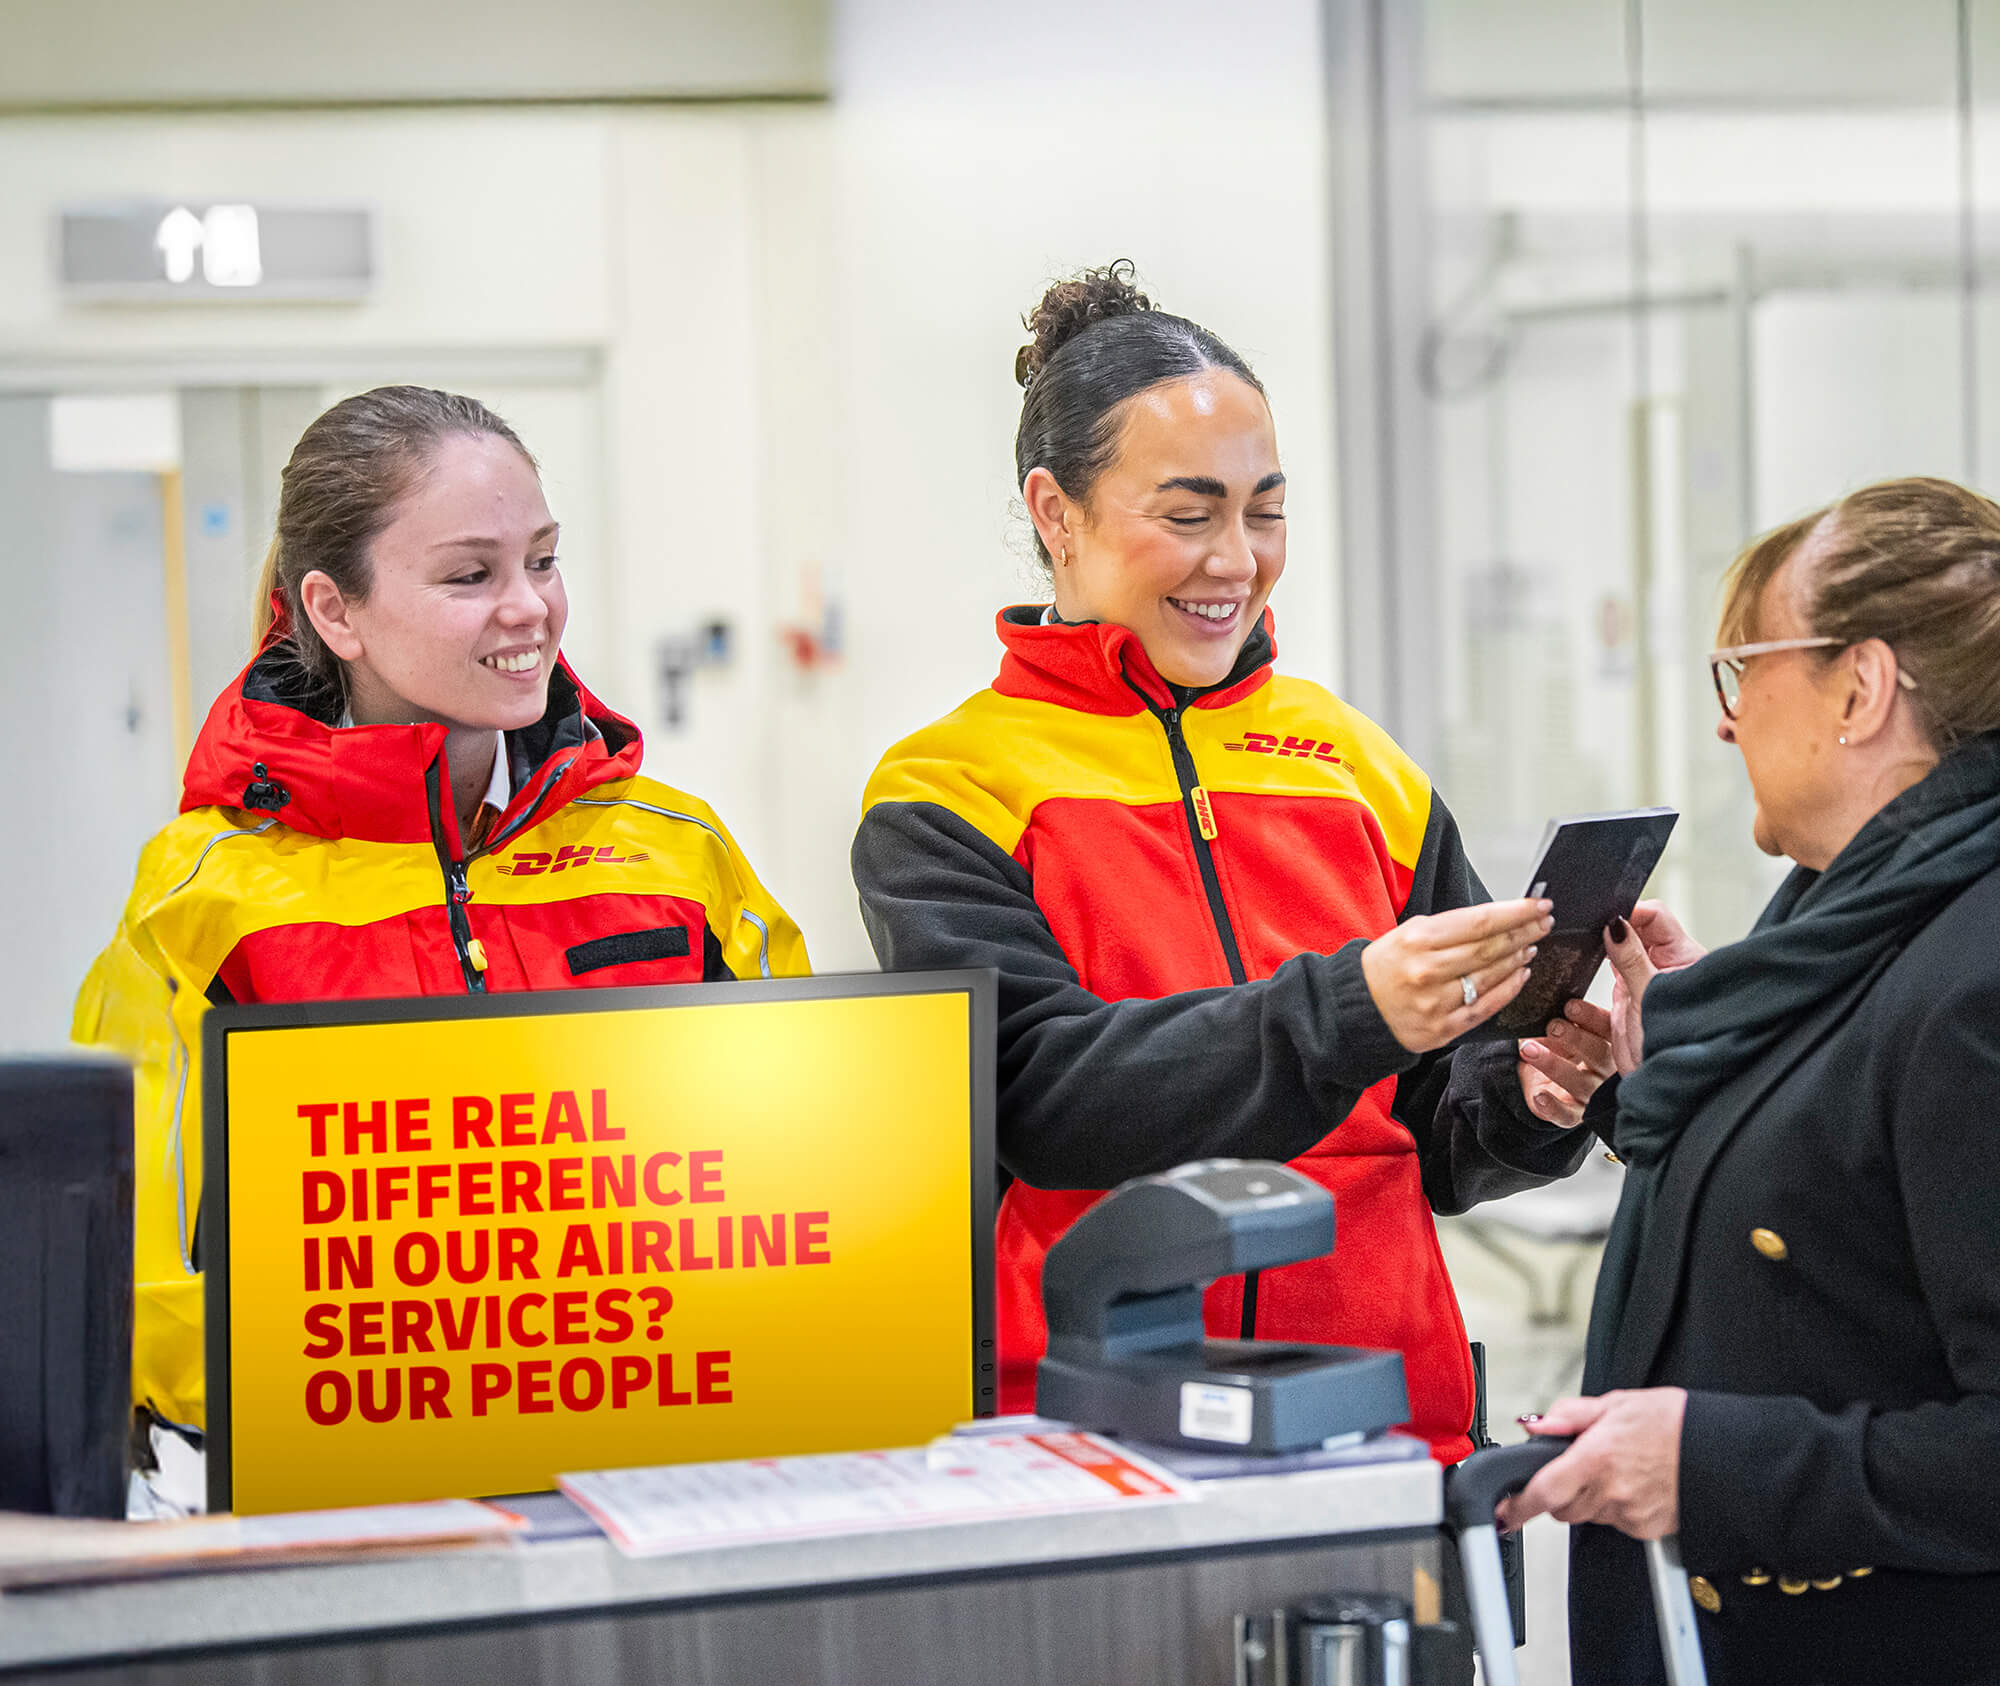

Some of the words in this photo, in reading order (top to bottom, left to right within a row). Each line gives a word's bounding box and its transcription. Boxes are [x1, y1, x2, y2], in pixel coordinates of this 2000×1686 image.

[1242, 732, 1343, 765] DHL
[510, 845, 627, 876] DHL
[297, 1098, 432, 1157] THE
[452, 1089, 626, 1150] REAL
[302, 1150, 725, 1225] DIFFERENCE
[303, 1235, 374, 1292] IN
[393, 1227, 542, 1287] OUR
[556, 1211, 831, 1279] AIRLINE
[302, 1286, 674, 1360] SERVICES?
[305, 1366, 453, 1426] OUR
[471, 1349, 733, 1417] PEOPLE
